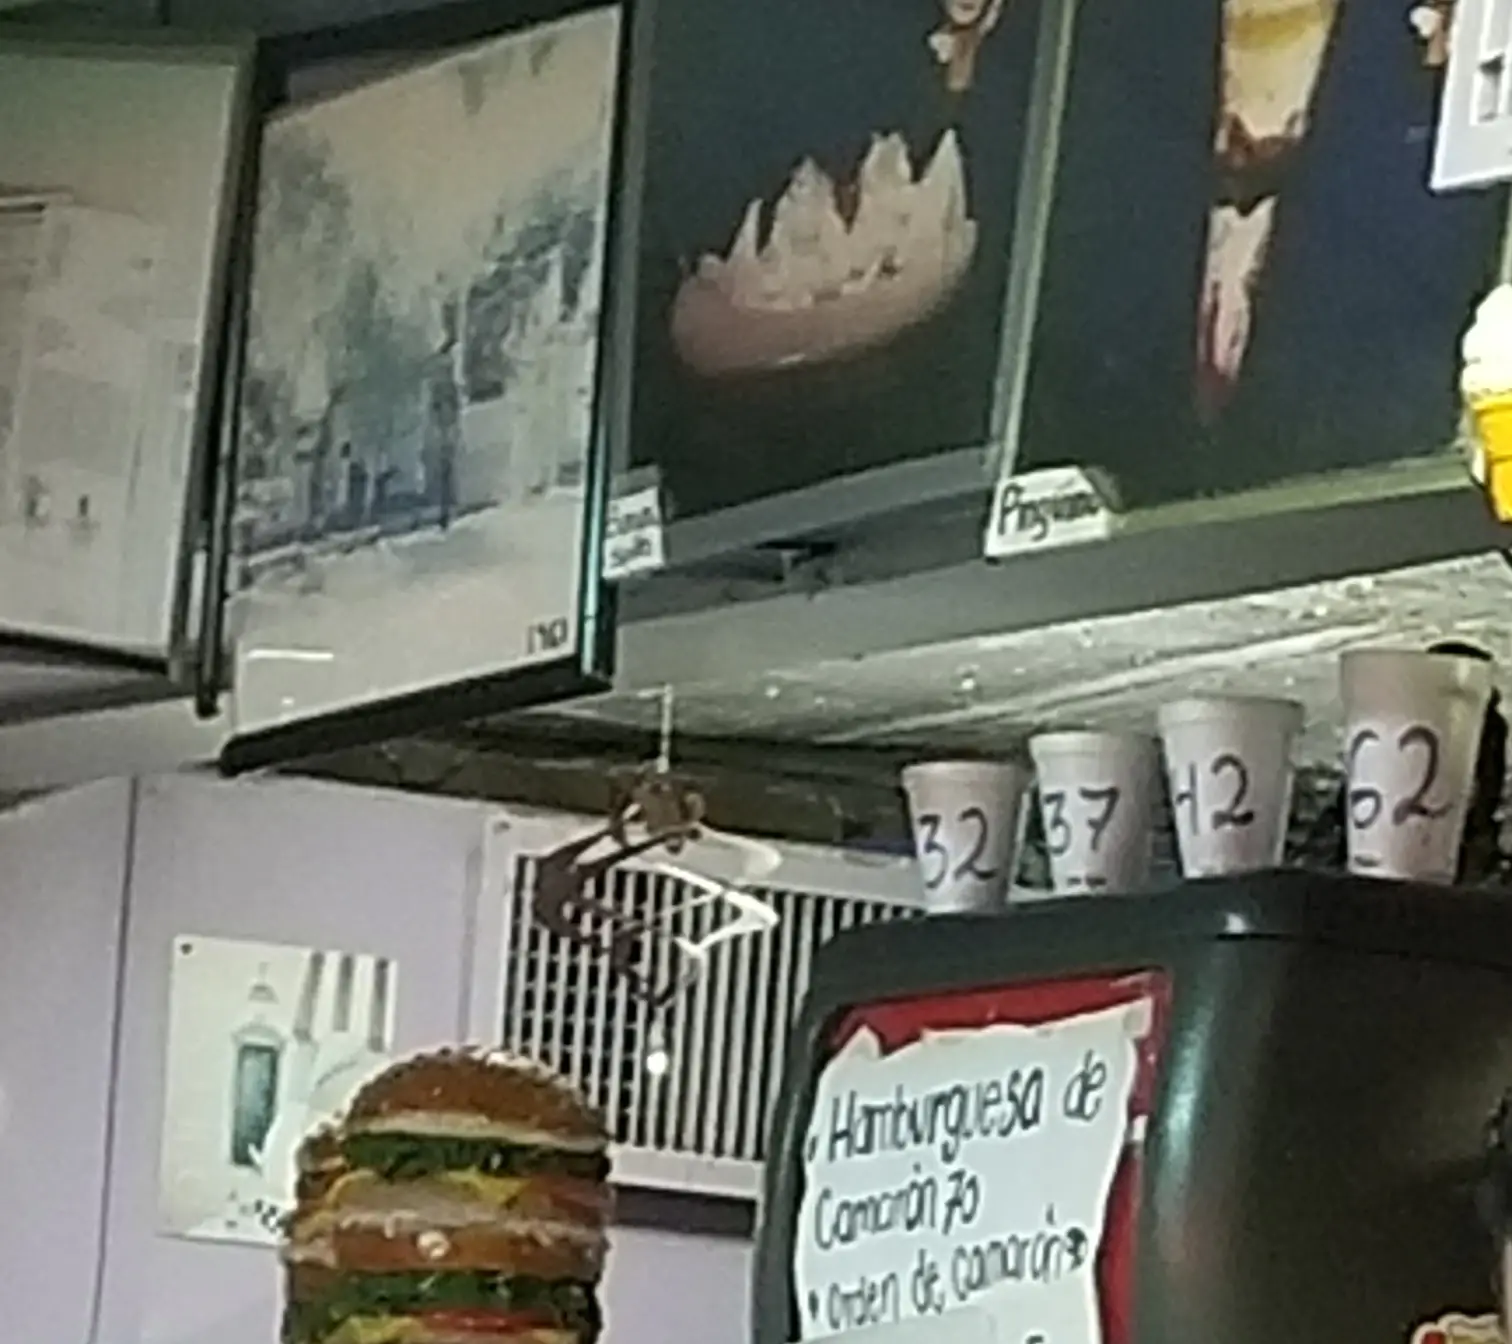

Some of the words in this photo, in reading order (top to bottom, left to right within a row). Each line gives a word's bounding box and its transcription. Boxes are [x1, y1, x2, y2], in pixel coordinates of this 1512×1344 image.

[1348, 727, 1457, 828] 62
[918, 806, 1001, 890] 32
[1043, 786, 1121, 858] 37
[828, 1067, 1044, 1164] Hamburguesa
[1063, 1050, 1108, 1122] de
[909, 1249, 946, 1317] de
